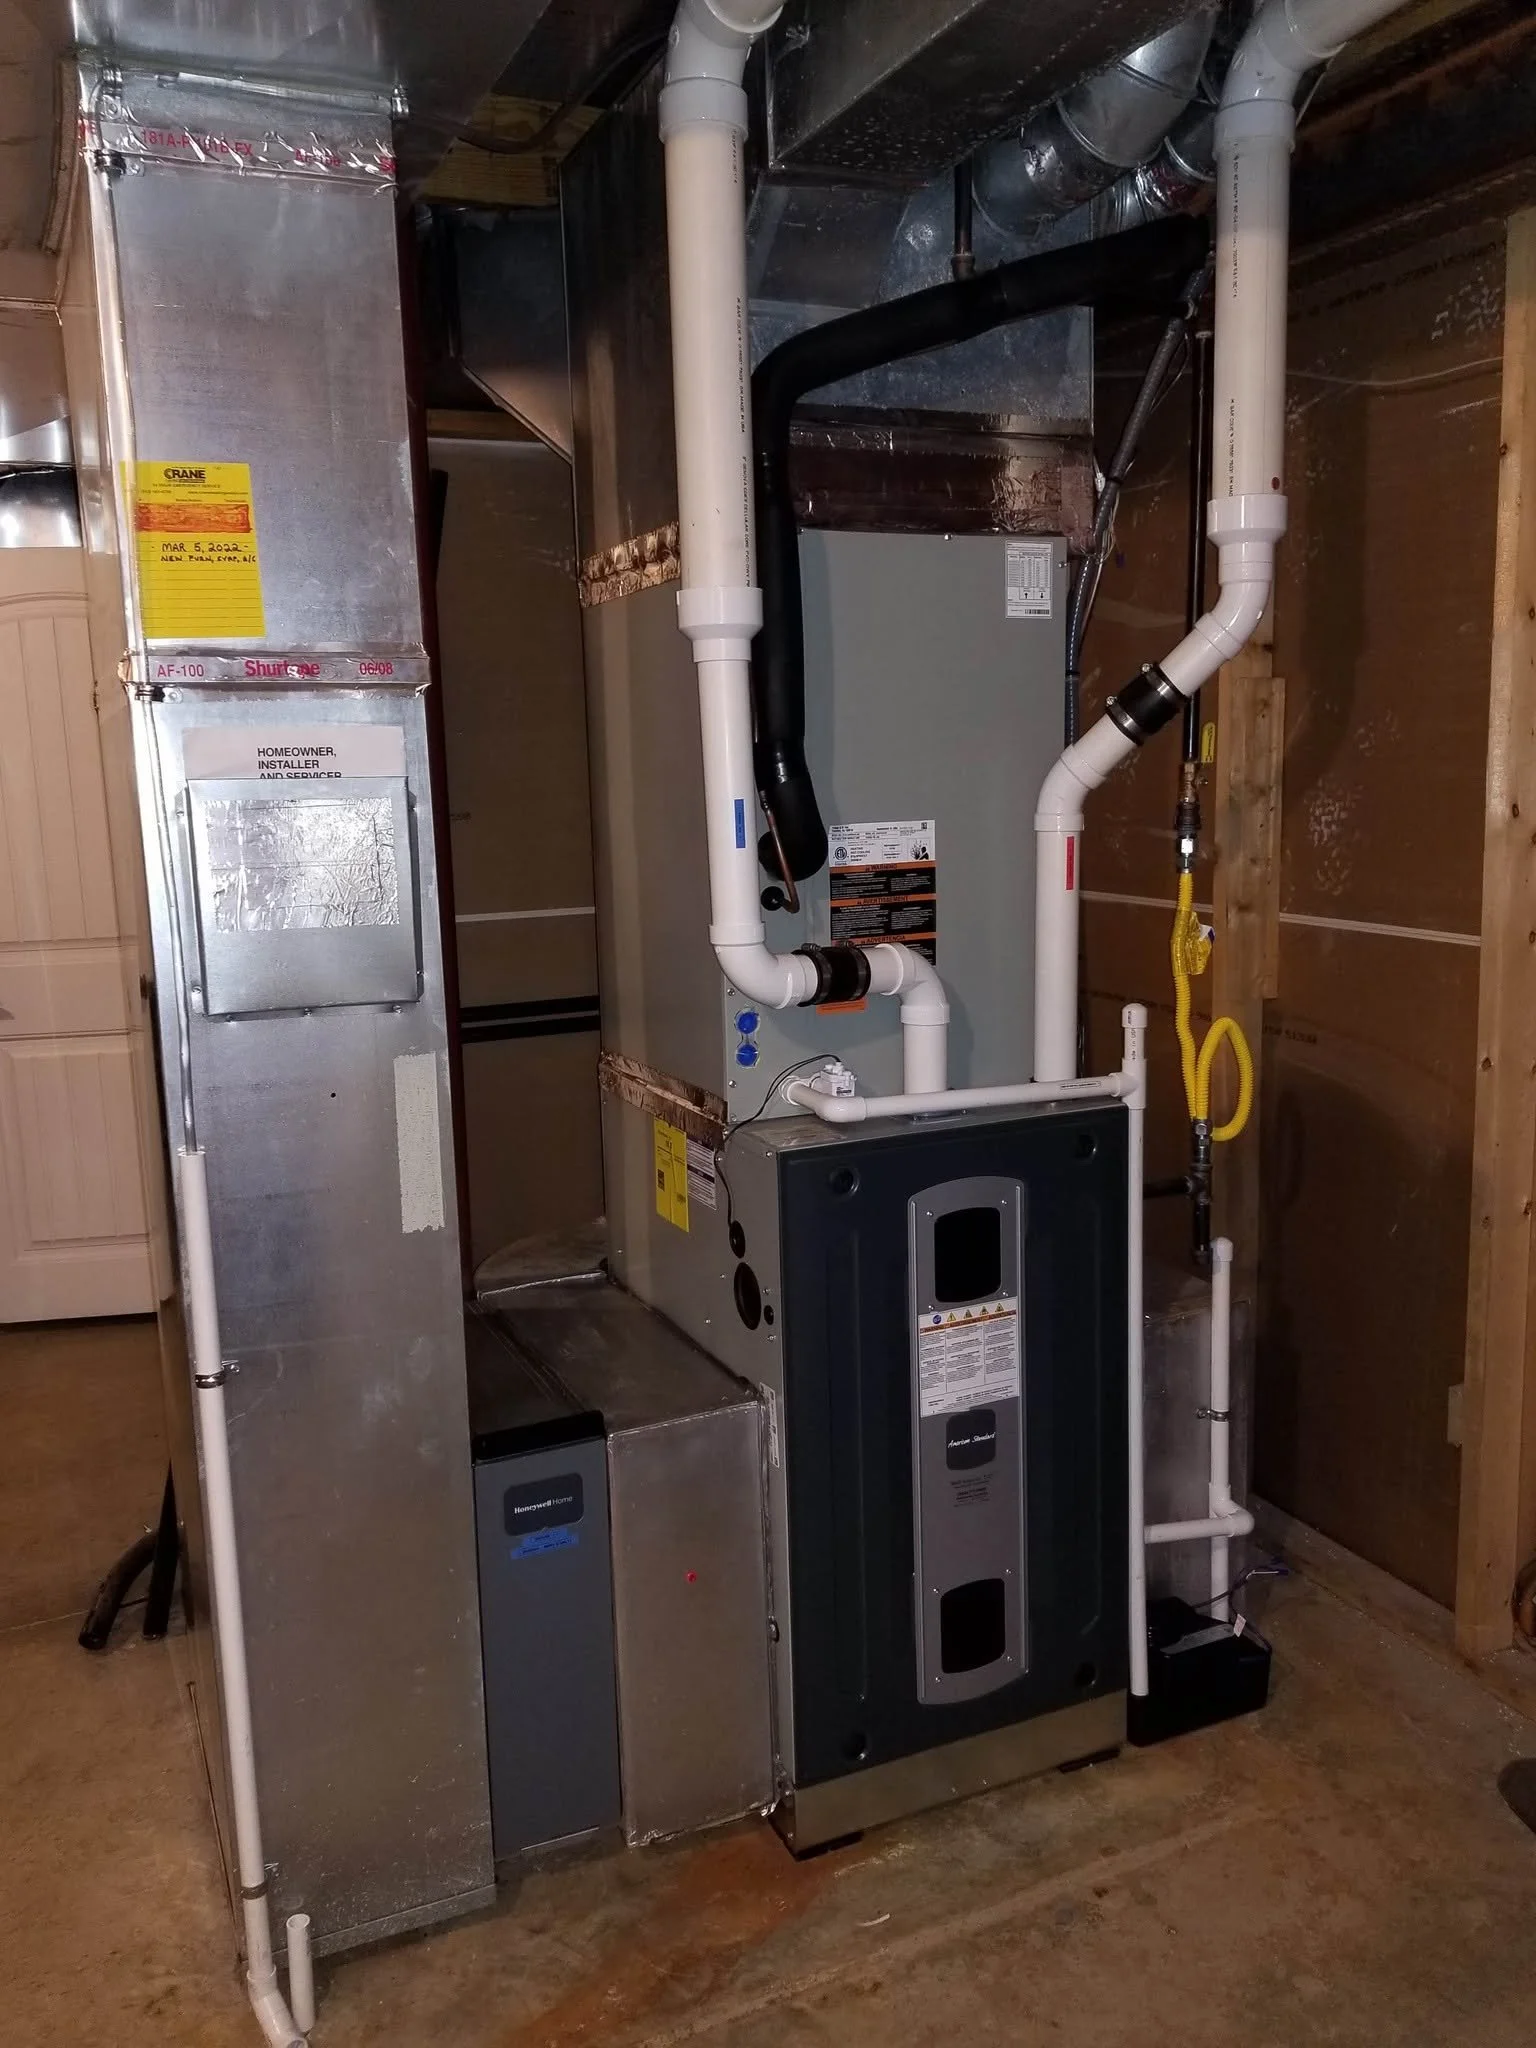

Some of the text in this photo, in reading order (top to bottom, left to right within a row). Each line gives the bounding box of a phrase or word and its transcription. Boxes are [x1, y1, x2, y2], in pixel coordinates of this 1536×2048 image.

[164, 468, 206, 479] CRANE
[162, 542, 187, 552] MAR
[157, 660, 393, 679] AF-100 Shurtpe 06/08
[257, 746, 337, 758] HOMEOWNER,
[258, 760, 320, 770] INSTALLER
[286, 771, 342, 779] SERVICER
[971, 1431, 996, 1443] Standard
[514, 1495, 573, 1514] Honeywell Home
